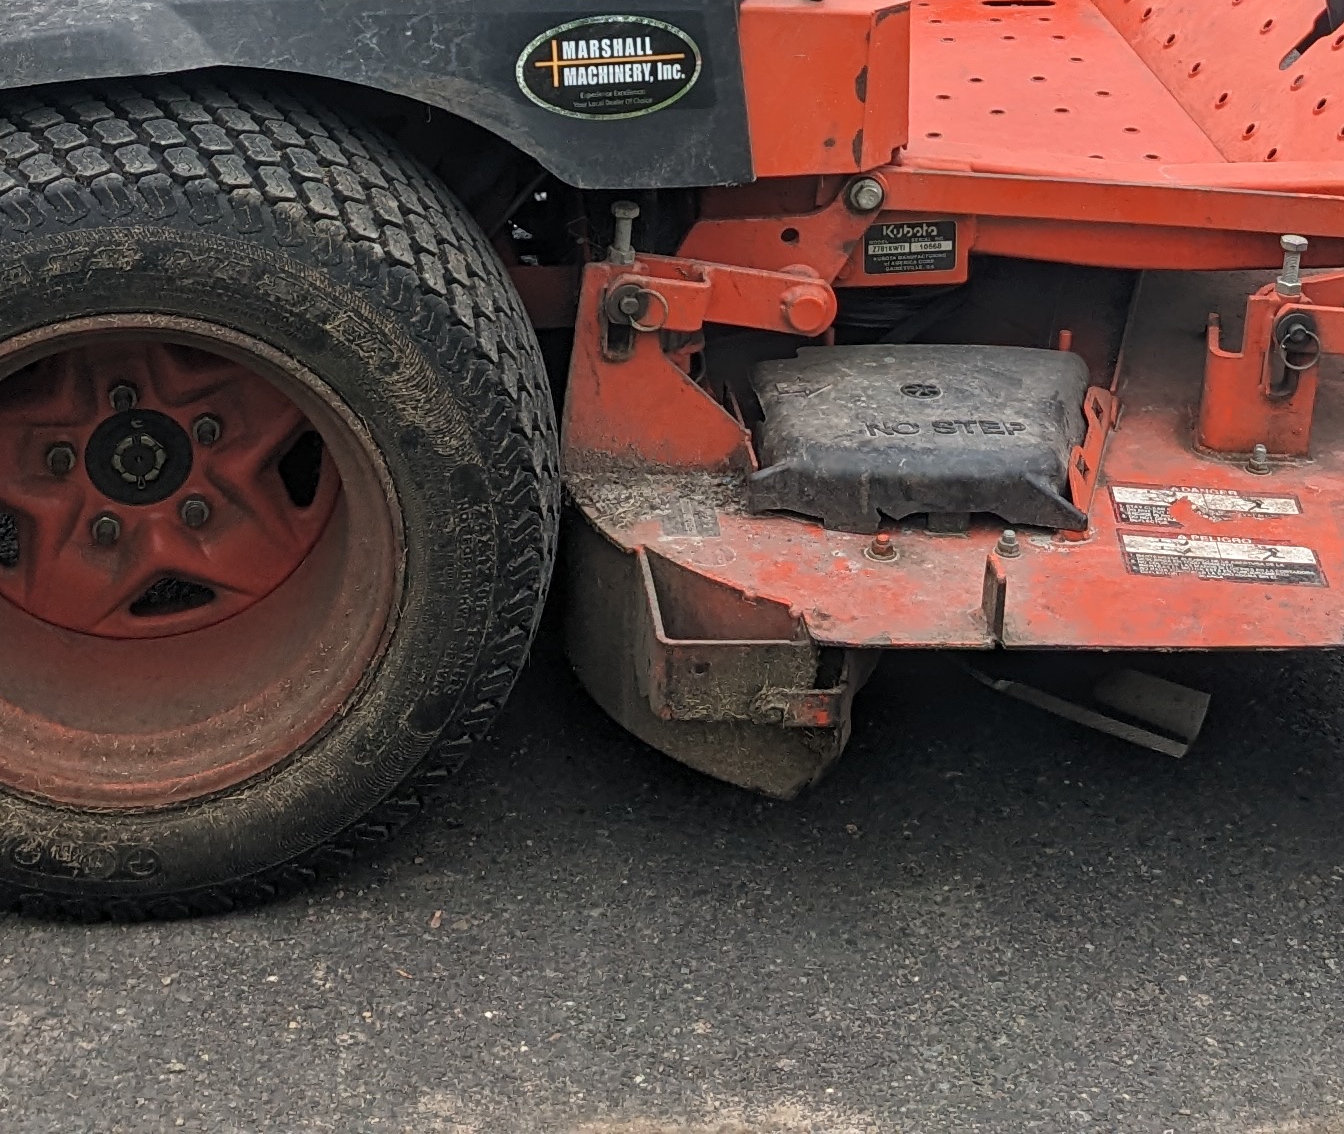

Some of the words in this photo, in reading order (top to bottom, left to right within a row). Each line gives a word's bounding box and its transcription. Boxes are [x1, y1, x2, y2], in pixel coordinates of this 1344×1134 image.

[562, 36, 653, 59] MARSHALL
[563, 62, 654, 86] MACHINERY,
[657, 62, 686, 81] Inc.
[882, 223, 938, 238] Kubota
[862, 421, 920, 437] NO
[931, 419, 1027, 436] STEP
[1181, 486, 1238, 496] DANGER
[1190, 534, 1252, 544] PELIGRO
